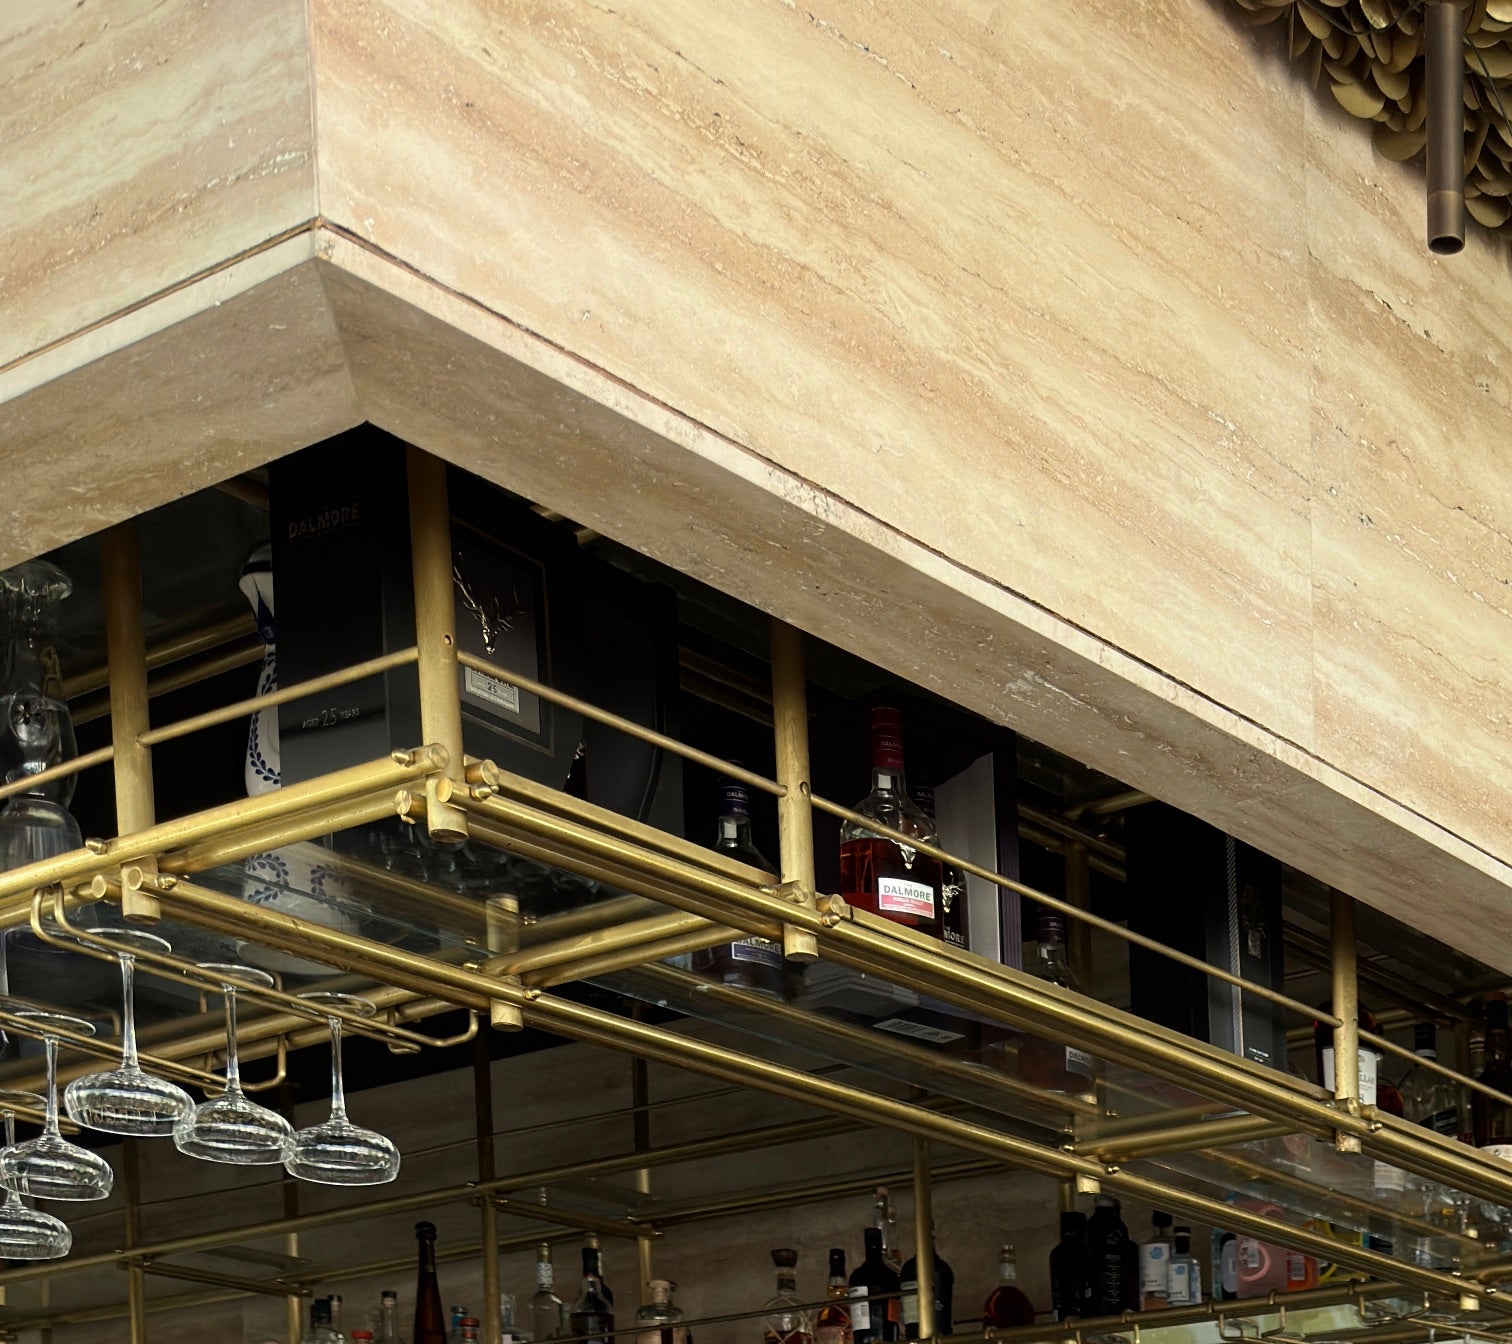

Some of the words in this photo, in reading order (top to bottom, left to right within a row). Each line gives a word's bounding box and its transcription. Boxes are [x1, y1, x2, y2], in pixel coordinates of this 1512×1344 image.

[288, 500, 360, 539] DALMORE
[321, 707, 337, 727] 25
[883, 884, 932, 902] DALMORE
